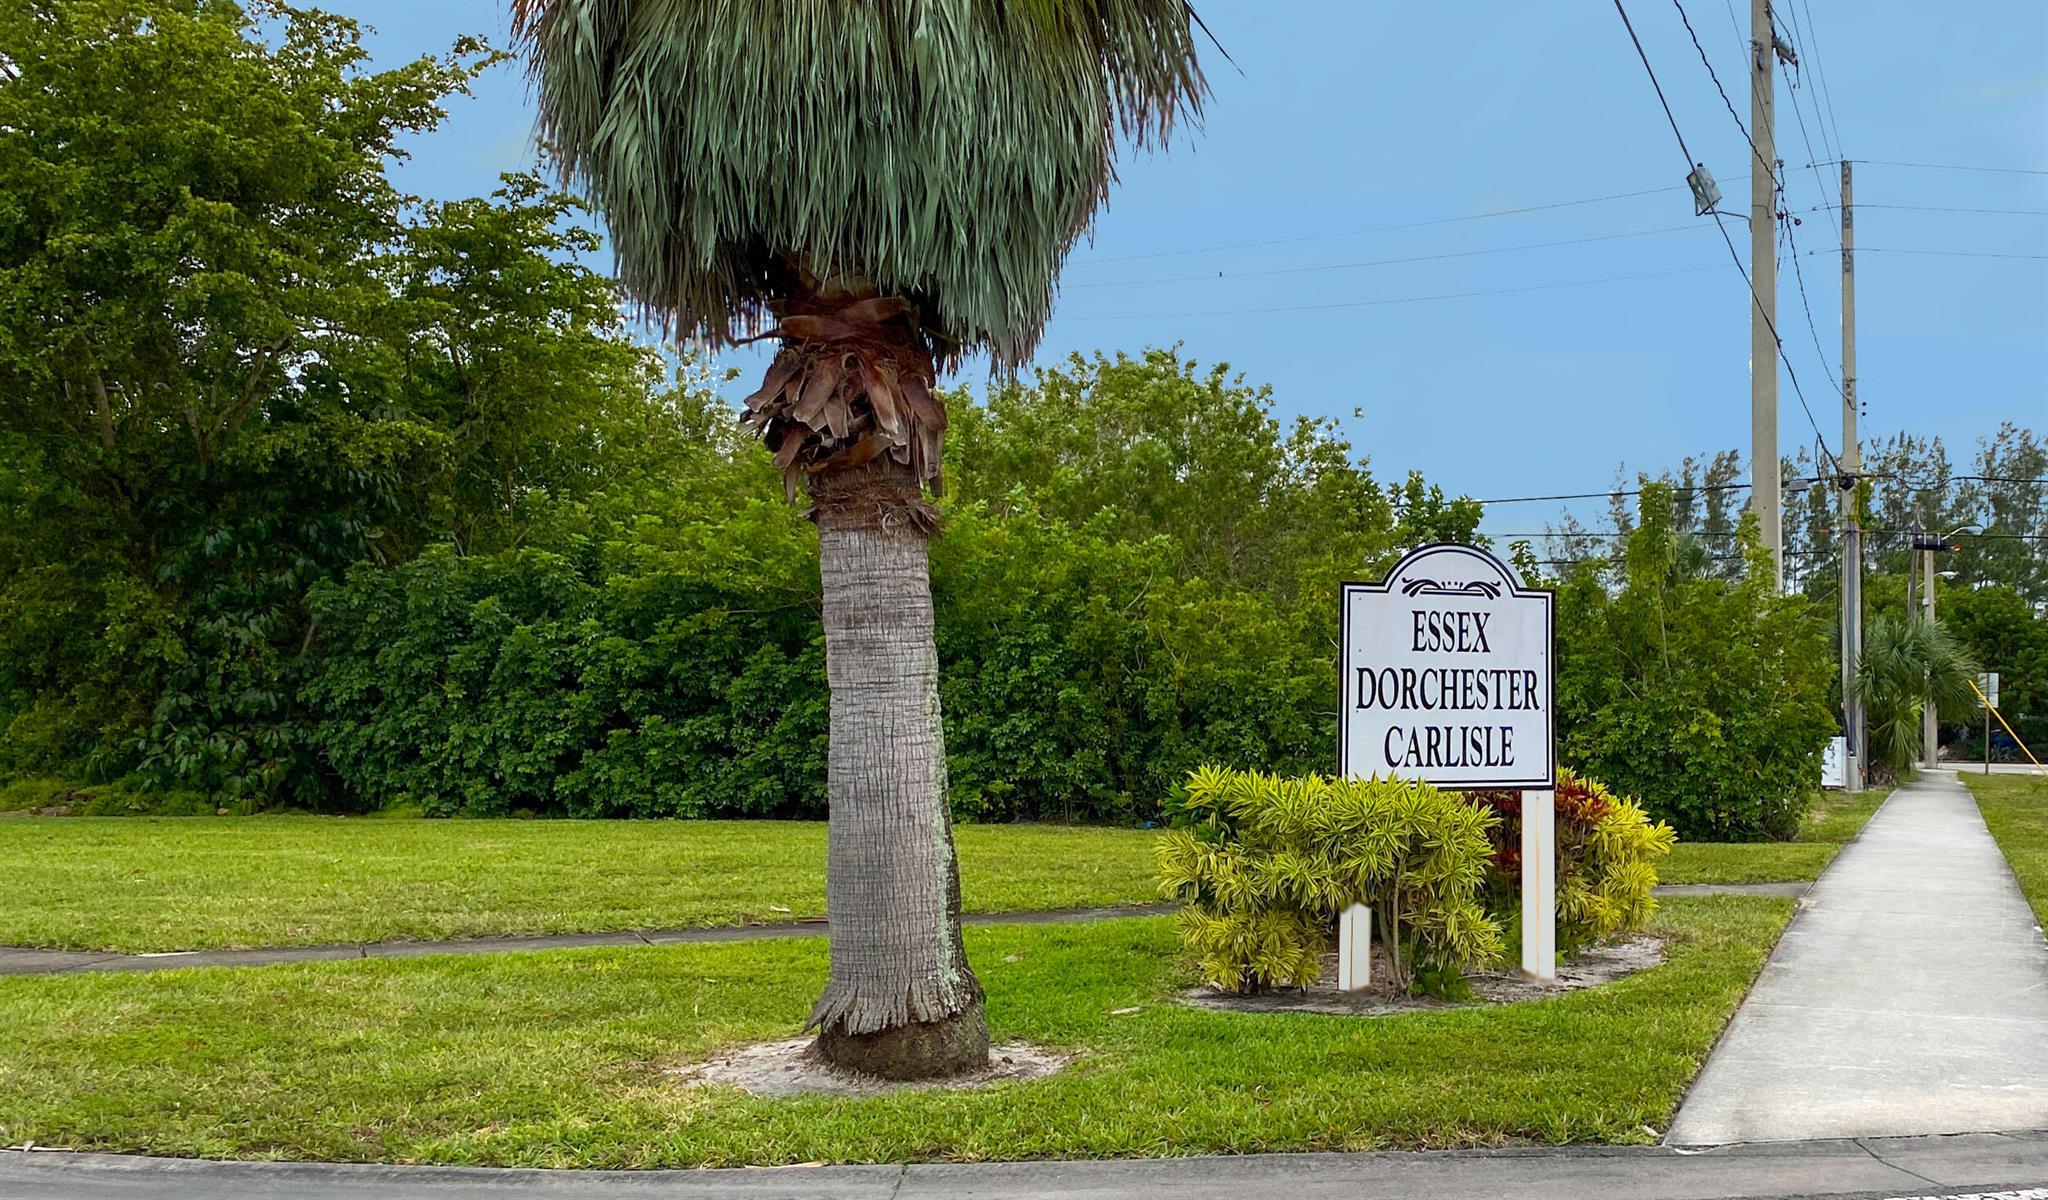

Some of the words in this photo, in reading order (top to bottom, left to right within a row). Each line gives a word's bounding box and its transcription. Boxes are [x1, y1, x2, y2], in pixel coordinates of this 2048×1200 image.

[1411, 610, 1491, 653] ESSEX
[1356, 667, 1540, 711] DORCHESTER
[1384, 725, 1515, 768] CARLISLE
